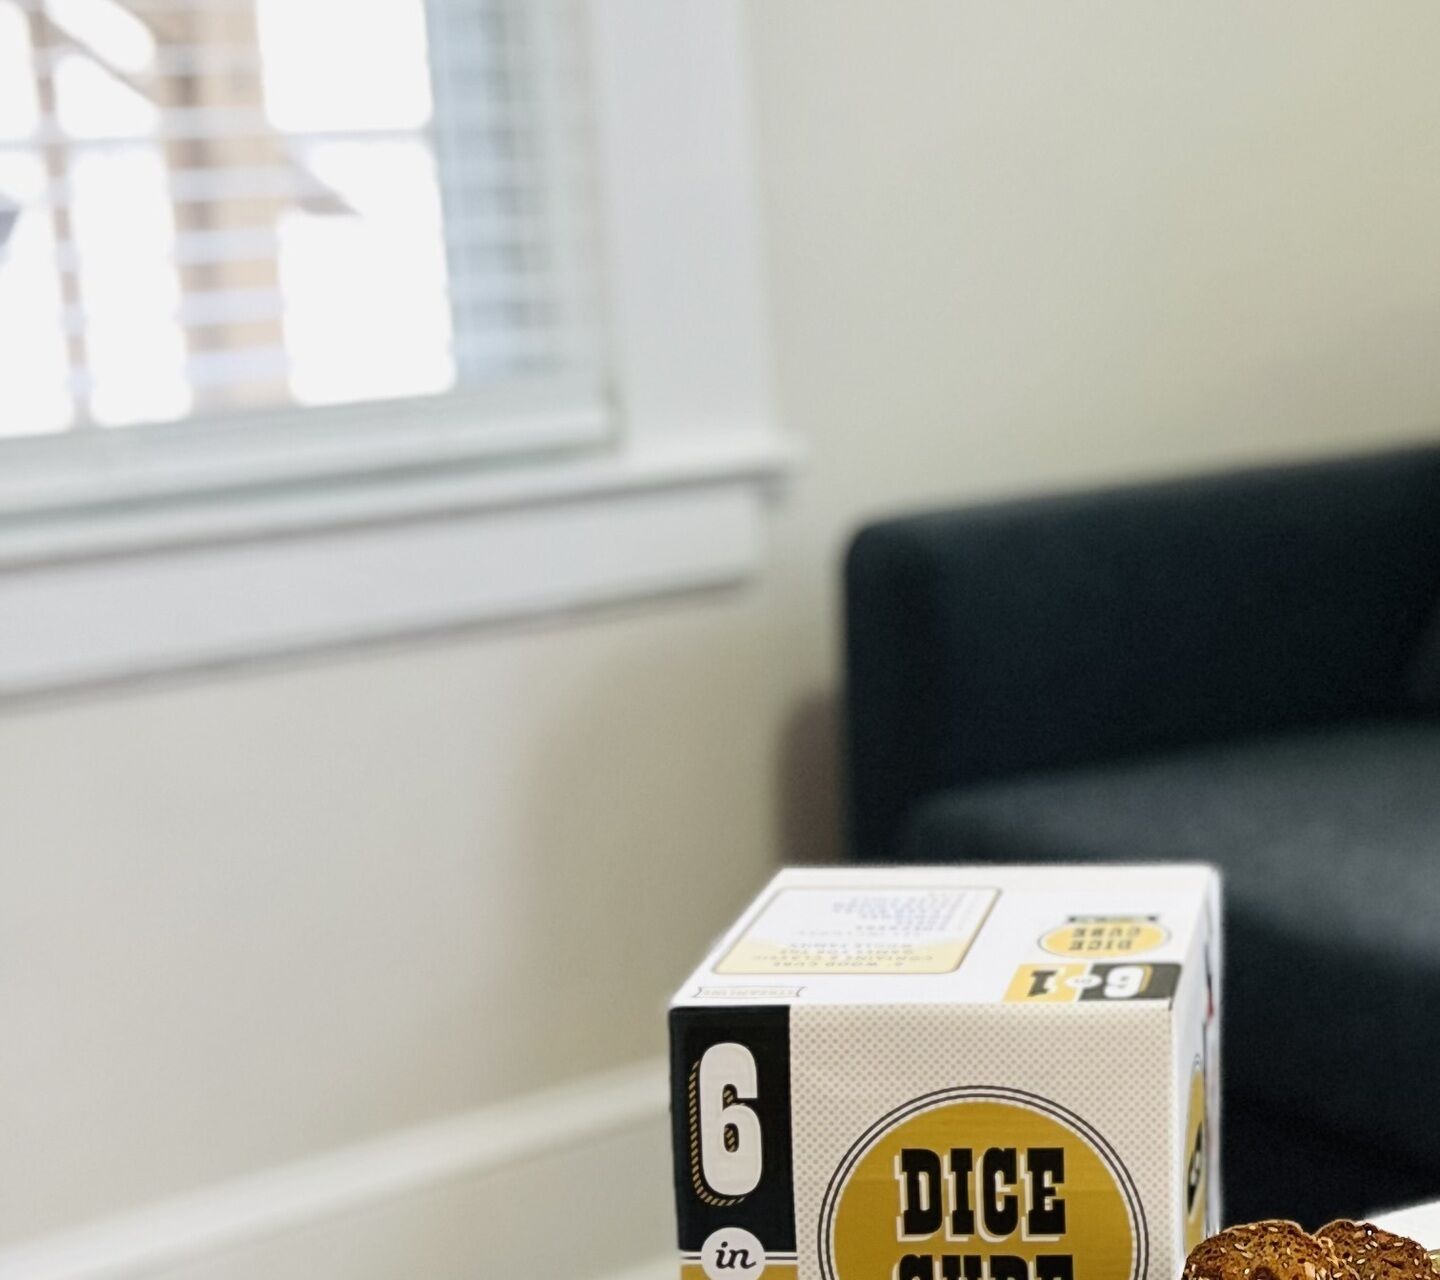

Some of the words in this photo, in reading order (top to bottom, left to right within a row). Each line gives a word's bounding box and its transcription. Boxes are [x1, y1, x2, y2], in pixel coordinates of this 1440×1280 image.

[1027, 970, 1058, 997] 1
[1104, 966, 1145, 998] 6
[698, 1041, 764, 1198] 6
[897, 1146, 1067, 1241] DICE
[714, 1240, 758, 1271] in
